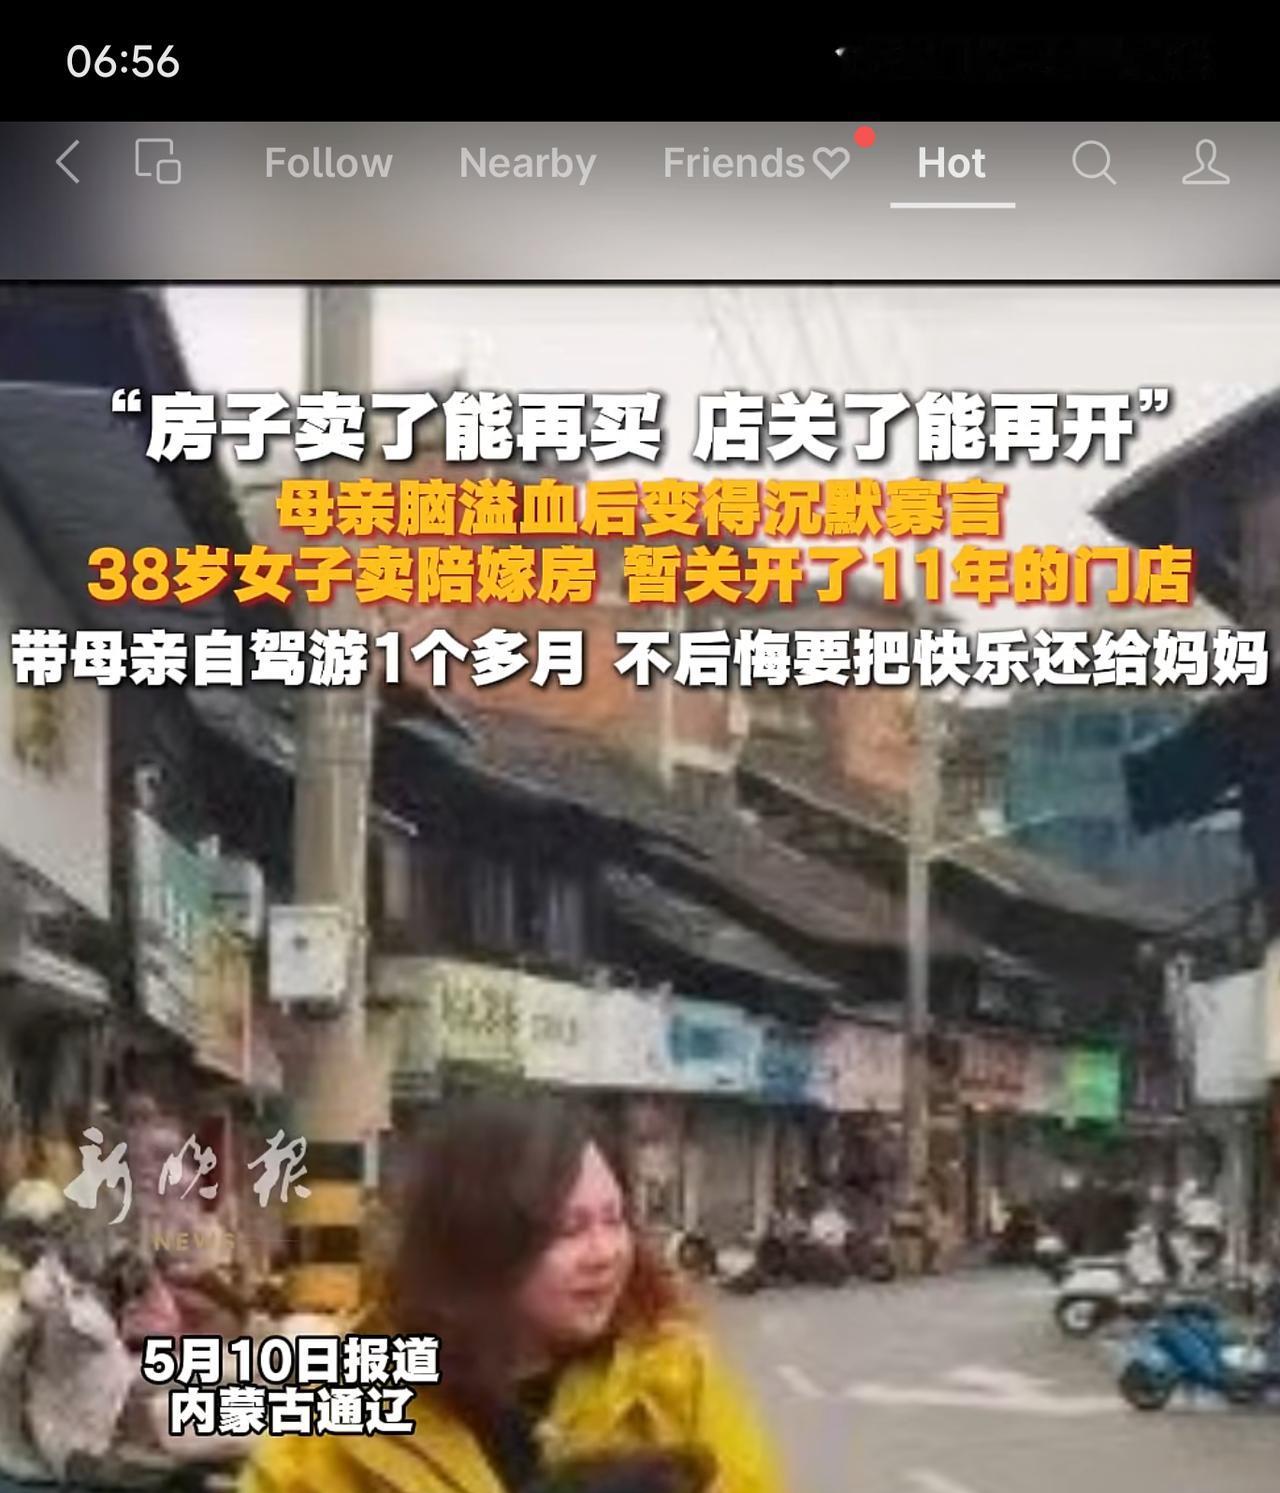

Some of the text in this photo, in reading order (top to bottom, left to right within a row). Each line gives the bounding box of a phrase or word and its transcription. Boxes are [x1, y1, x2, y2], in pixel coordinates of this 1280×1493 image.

[66, 44, 181, 79] 06:56
[265, 146, 393, 180] Follow
[460, 146, 597, 187] Nearby
[664, 146, 805, 180] Friends
[919, 146, 986, 180] Hot
